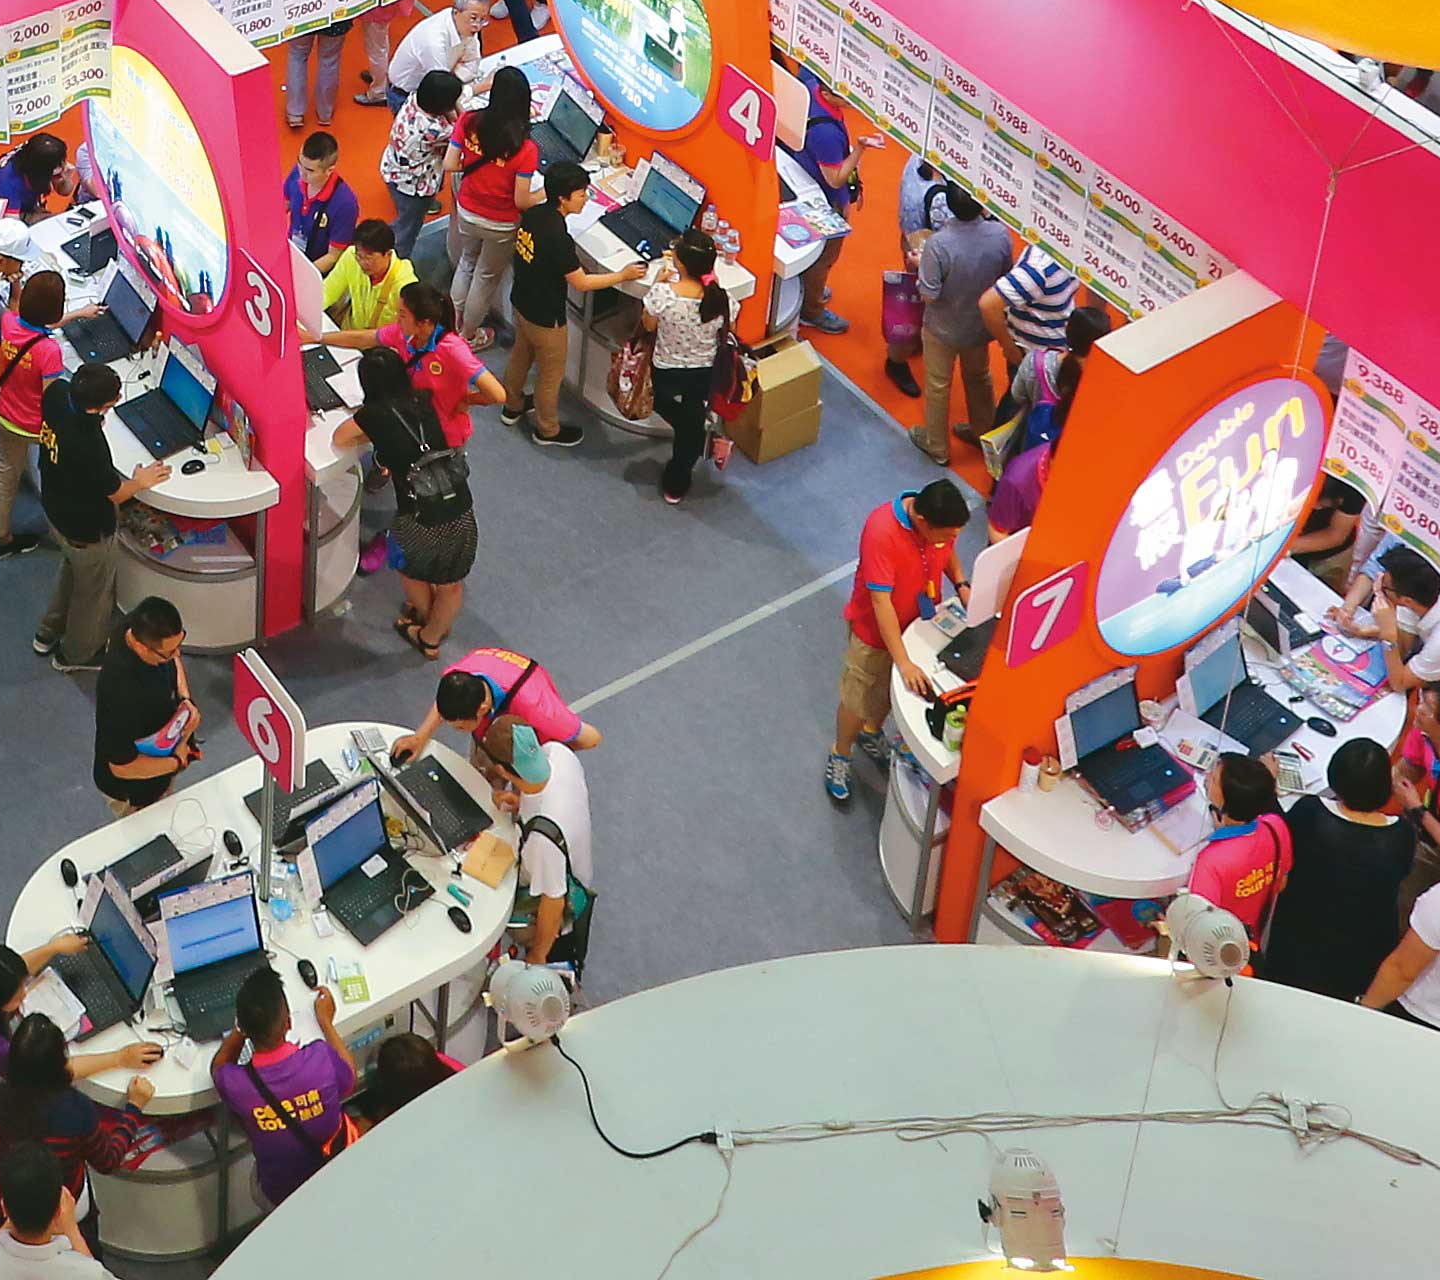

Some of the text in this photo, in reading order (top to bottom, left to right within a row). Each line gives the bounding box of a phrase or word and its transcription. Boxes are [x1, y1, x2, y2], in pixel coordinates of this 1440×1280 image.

[729, 87, 762, 147] 4
[245, 270, 273, 338] 3
[1030, 581, 1073, 655] 7
[245, 695, 278, 763] 6
